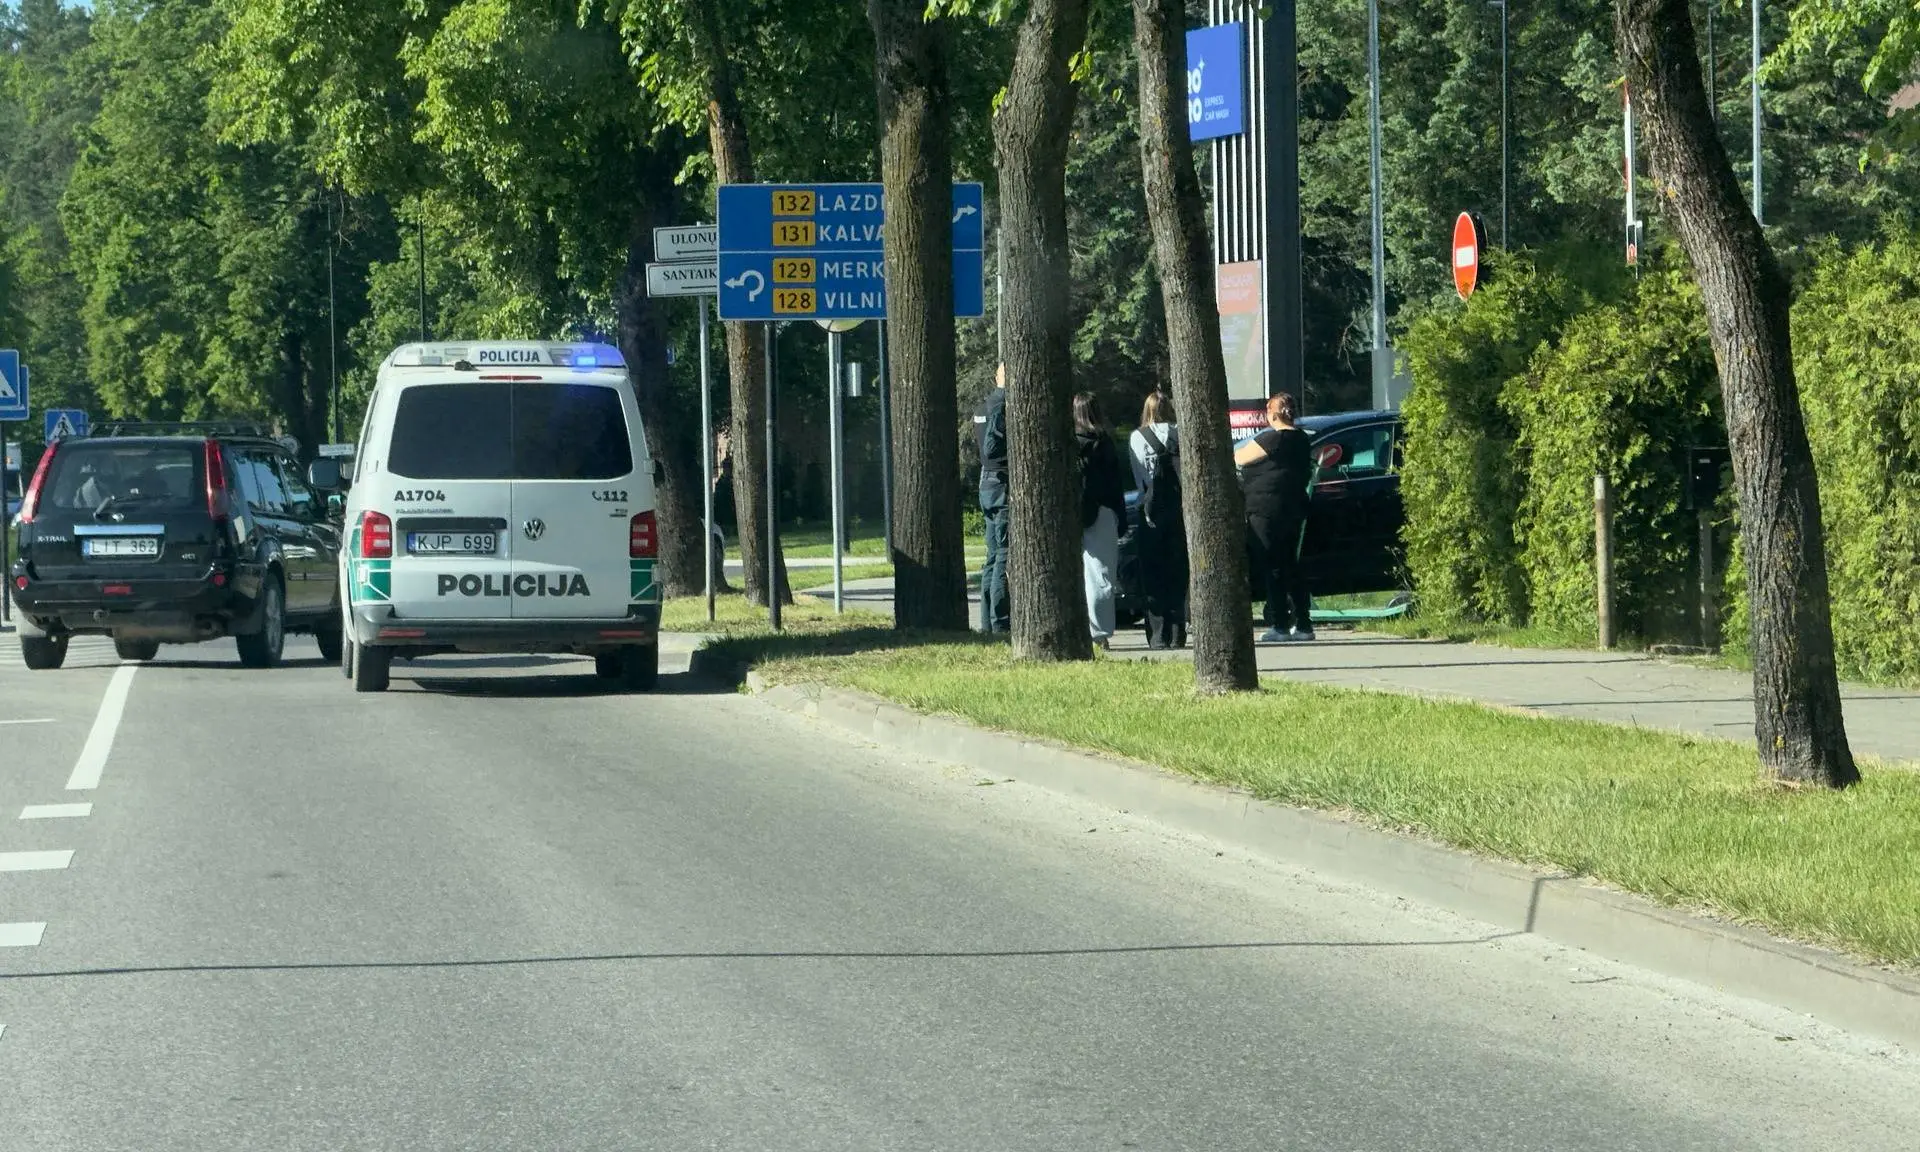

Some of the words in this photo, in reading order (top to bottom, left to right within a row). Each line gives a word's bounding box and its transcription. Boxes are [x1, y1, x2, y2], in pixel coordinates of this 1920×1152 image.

[778, 195, 810, 212] 132
[671, 232, 717, 245] ULONŲ
[780, 225, 809, 242] 131
[819, 225, 885, 242] KALVA
[663, 268, 717, 281] SANTAIK
[778, 262, 811, 279] 129
[823, 261, 885, 278] MERK
[778, 292, 811, 309] 128
[824, 291, 882, 309] VILNI
[479, 350, 541, 362] POLICIJA
[394, 490, 446, 502] A1704
[603, 490, 628, 502] 112
[37, 535, 67, 543] X-TRAIL
[418, 535, 452, 550] KJP
[463, 535, 493, 550] 699
[91, 541, 120, 553] LIT
[130, 540, 156, 553] 362
[437, 573, 592, 597] POLICIJA
